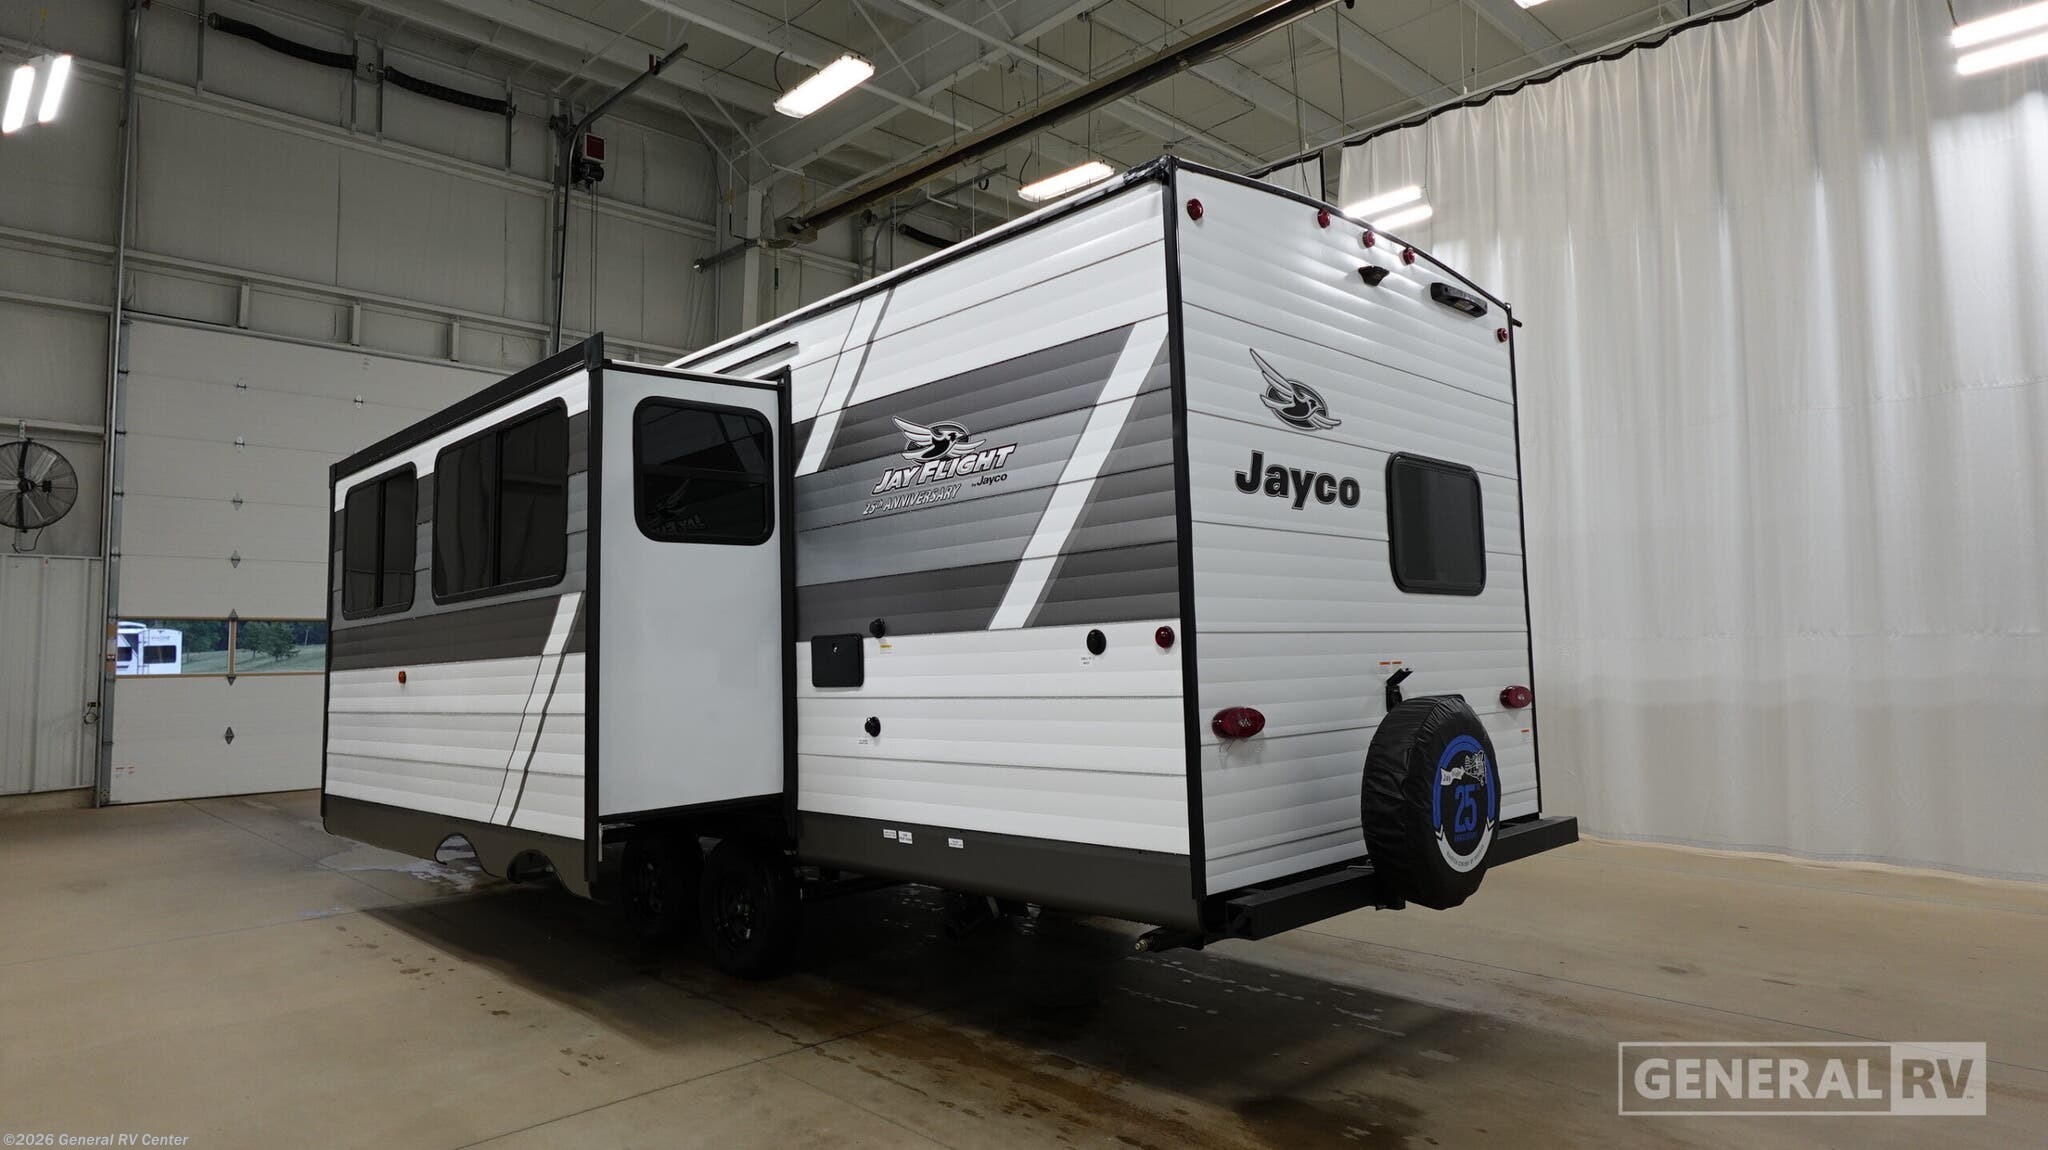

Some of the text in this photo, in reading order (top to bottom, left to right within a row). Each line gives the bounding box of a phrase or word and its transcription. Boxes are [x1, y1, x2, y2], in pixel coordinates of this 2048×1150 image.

[872, 443, 1018, 495] JAY FLIGHT
[976, 473, 1008, 486] Jayco
[1235, 449, 1361, 510] Jayco
[882, 484, 962, 511] ANNIVERSARY
